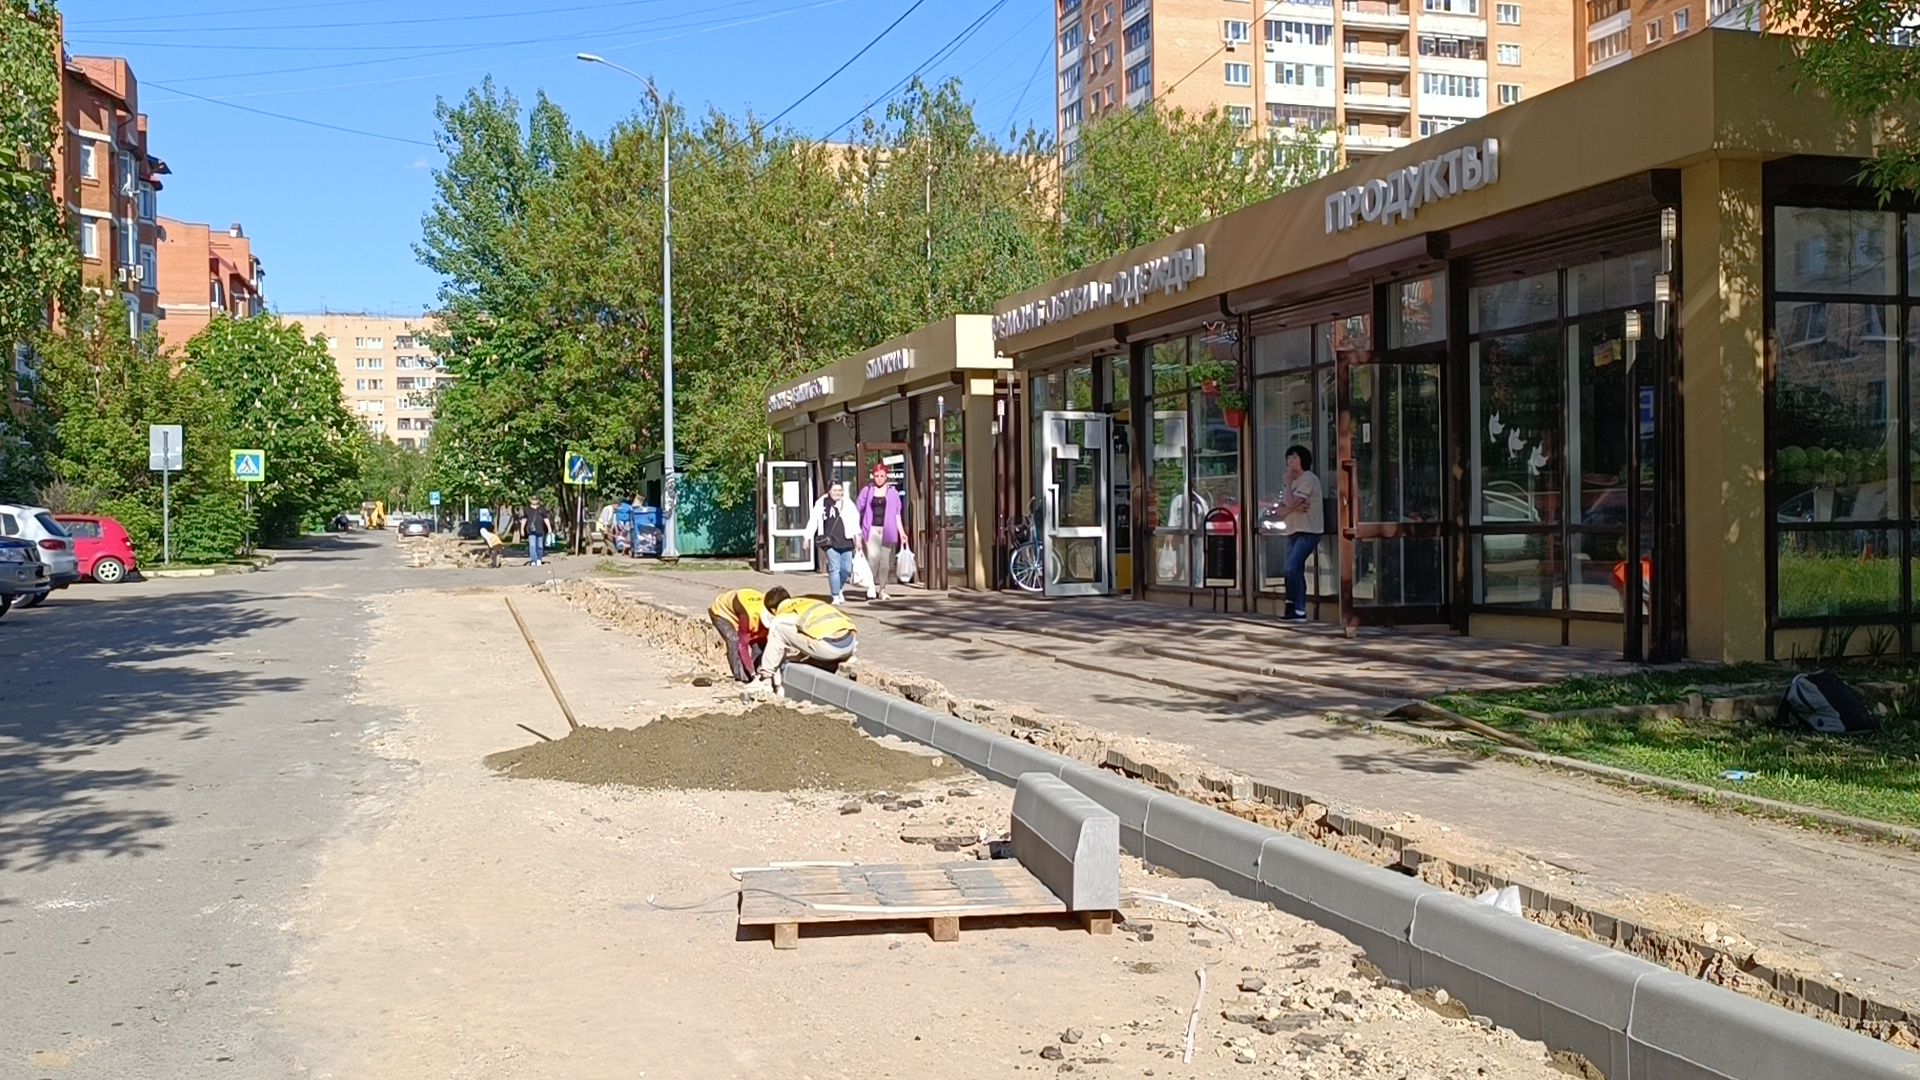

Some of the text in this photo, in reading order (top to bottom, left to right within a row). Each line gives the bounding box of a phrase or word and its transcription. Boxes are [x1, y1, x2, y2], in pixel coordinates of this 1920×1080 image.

[1325, 138, 1498, 234] ПРОДУКТЫ
[992, 300, 1046, 341] РЕМОНТ
[1046, 281, 1098, 325] ОБУВИ
[1112, 243, 1206, 308] ОДЕЖДЫ
